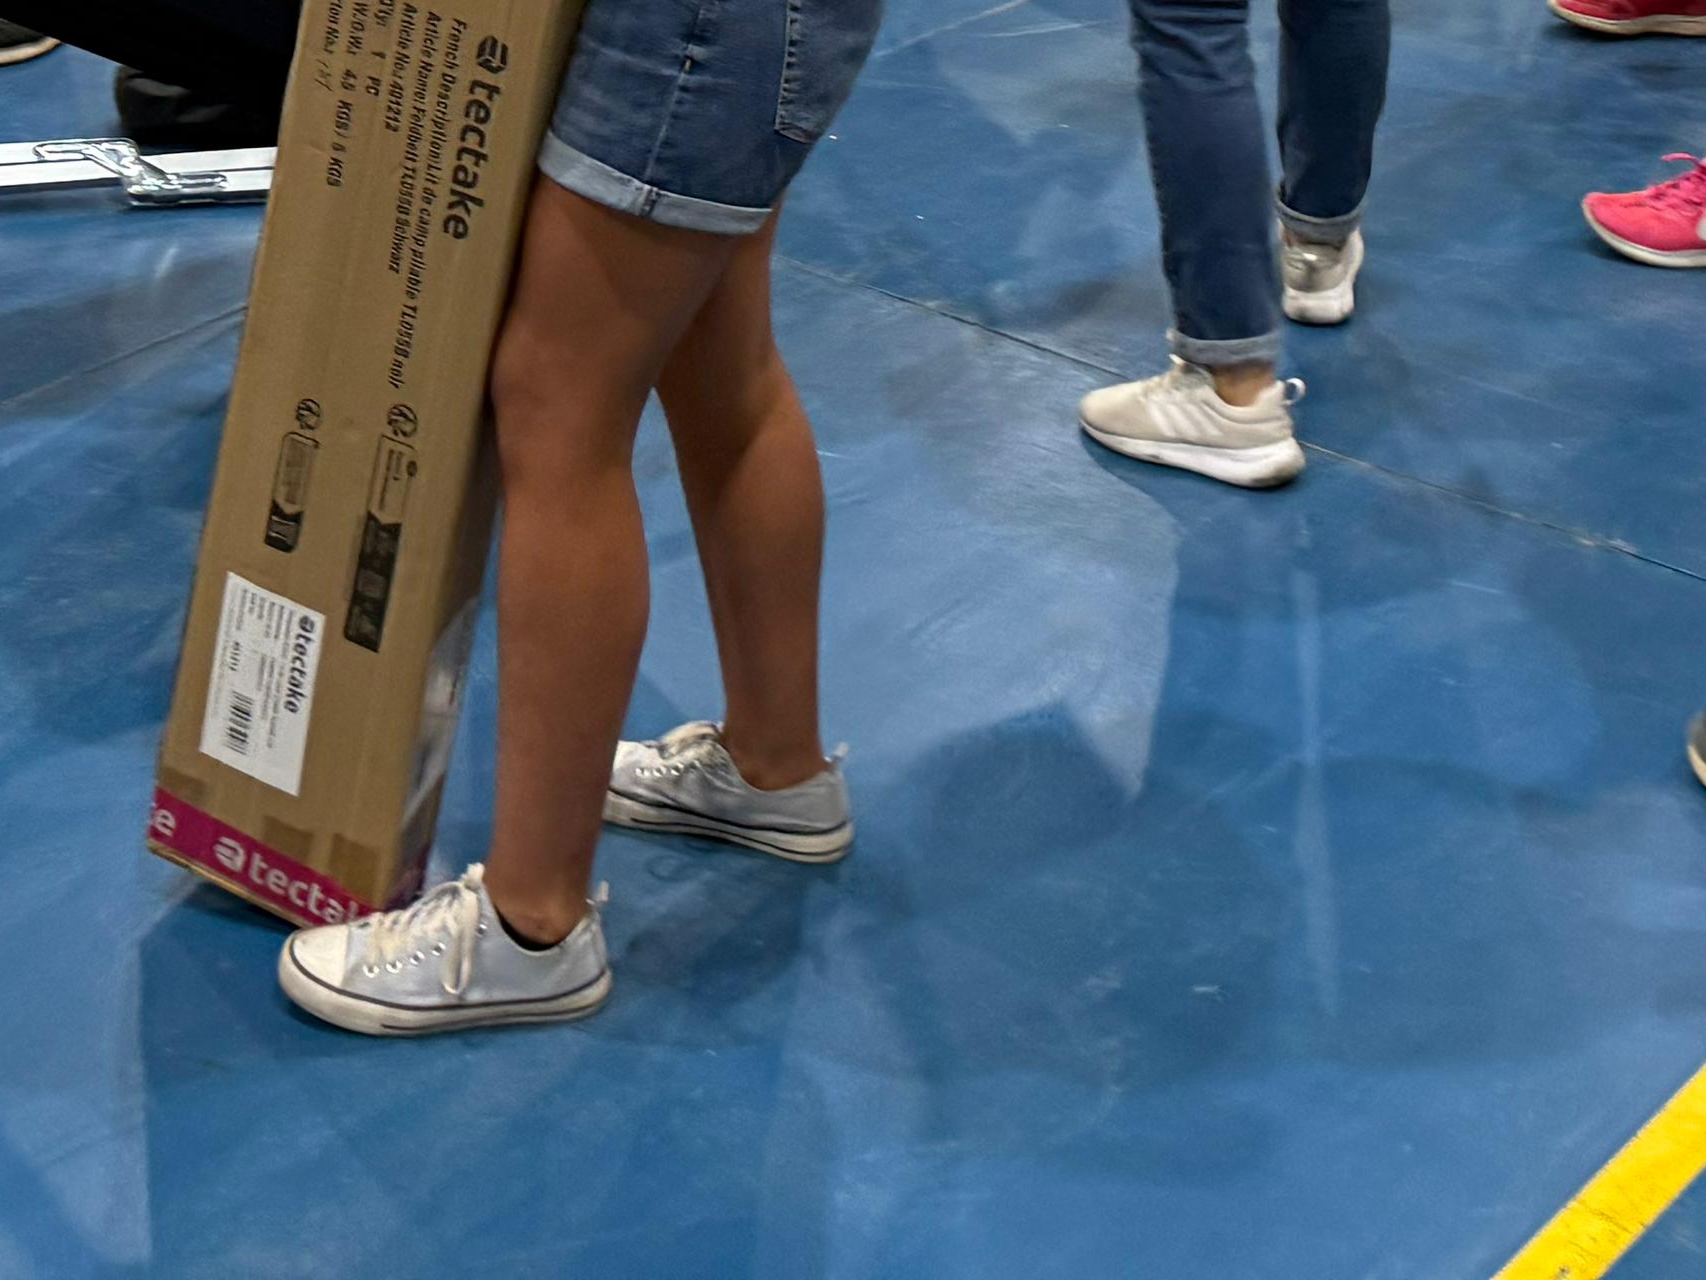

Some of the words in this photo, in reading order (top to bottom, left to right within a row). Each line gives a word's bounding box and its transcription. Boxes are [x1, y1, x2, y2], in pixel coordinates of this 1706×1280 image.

[396, 2, 419, 50] Article
[420, 10, 443, 59] Article
[442, 17, 468, 71] French
[442, 79, 502, 240] tectake
